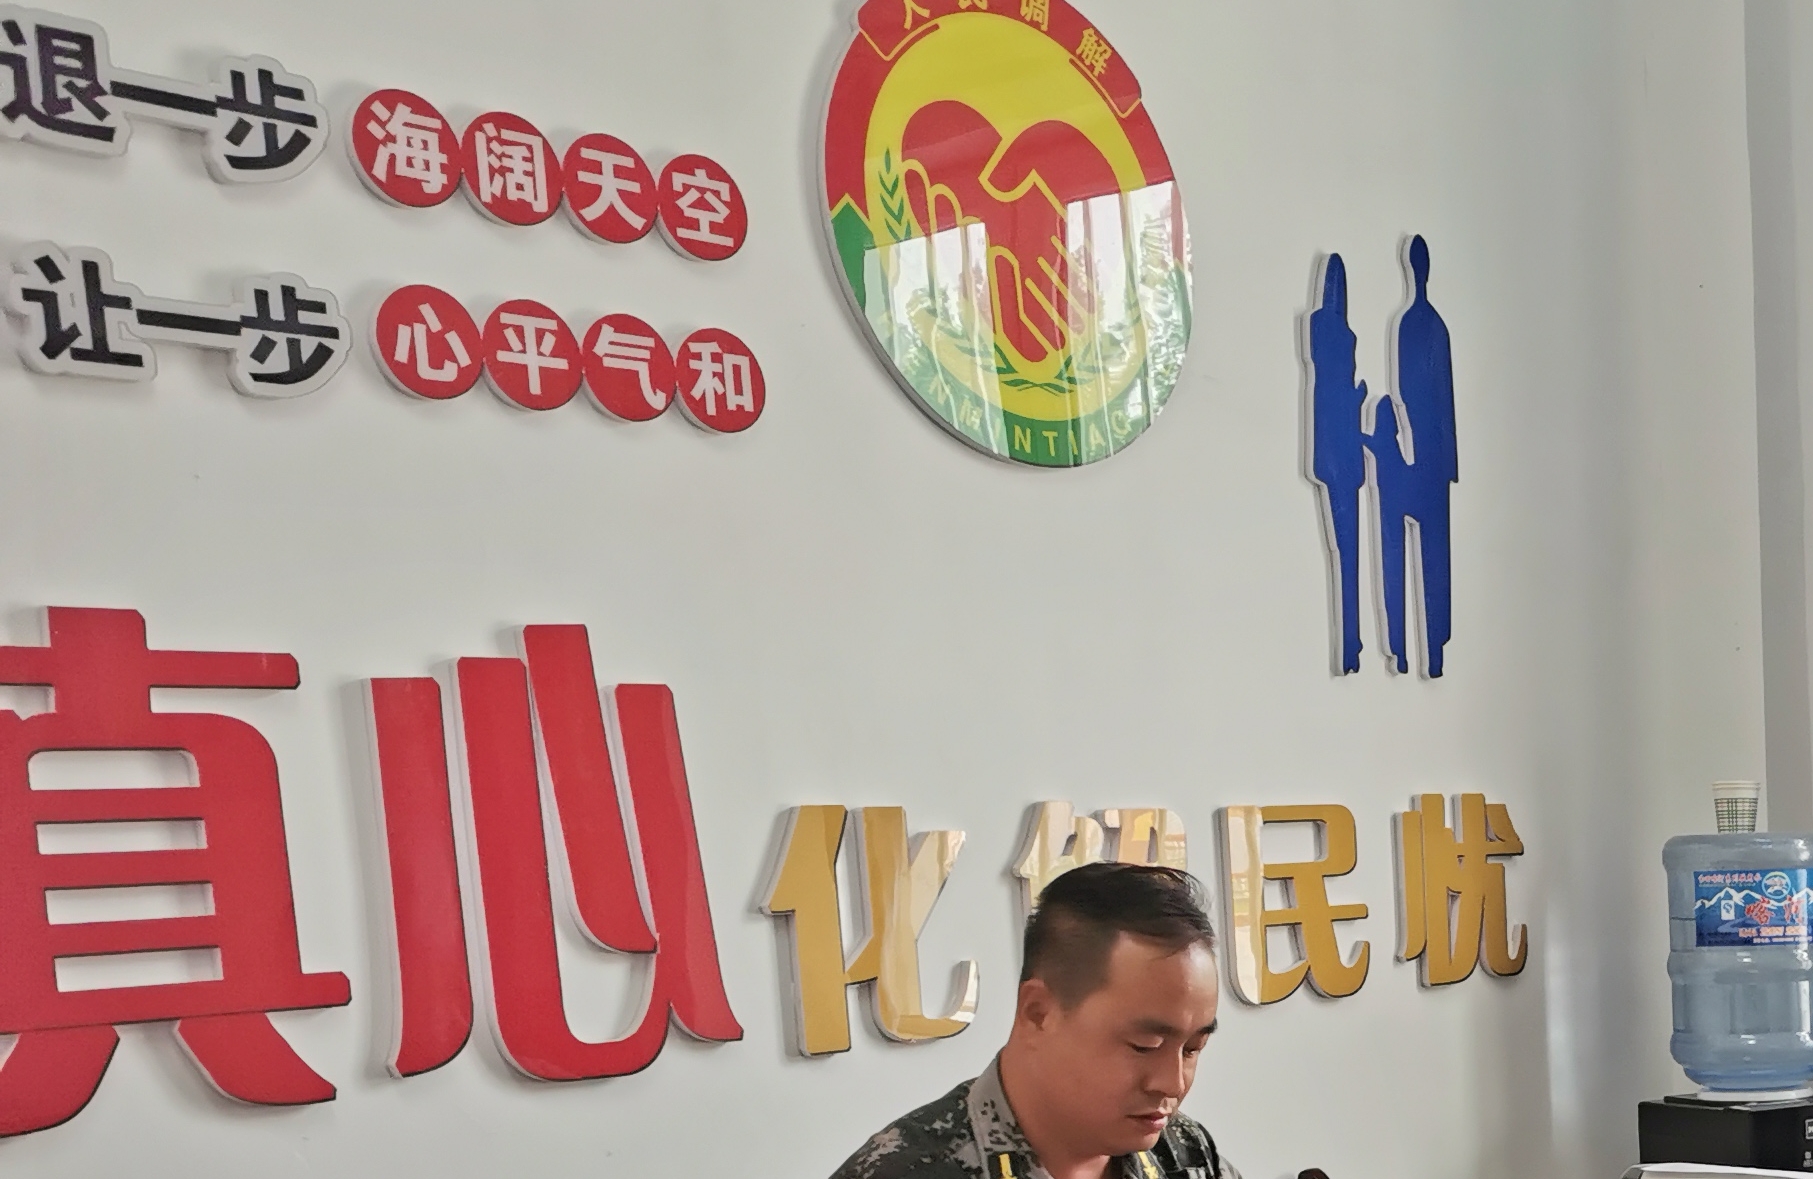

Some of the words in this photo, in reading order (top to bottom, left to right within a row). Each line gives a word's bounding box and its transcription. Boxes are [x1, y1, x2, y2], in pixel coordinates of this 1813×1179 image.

[0, 20, 318, 170] 退一步
[367, 101, 735, 247] 海阔天空
[903, 0, 1112, 77] 人调解
[22, 255, 340, 385] 让一步
[395, 303, 755, 416] 心平气和
[0, 606, 744, 1138] 真心
[757, 792, 1528, 1056] 化民忧
